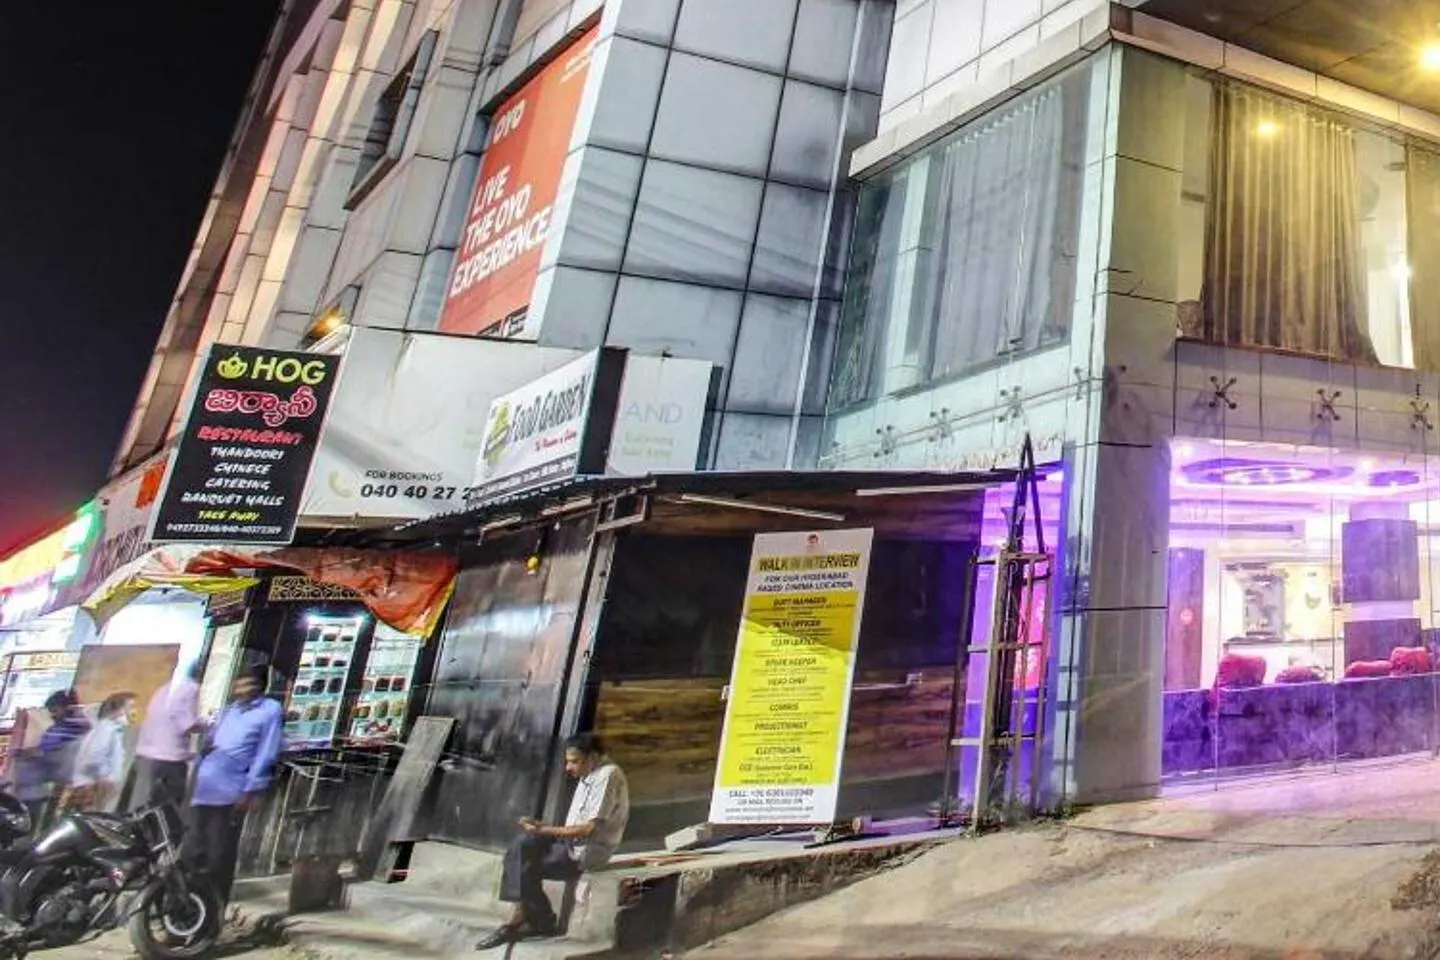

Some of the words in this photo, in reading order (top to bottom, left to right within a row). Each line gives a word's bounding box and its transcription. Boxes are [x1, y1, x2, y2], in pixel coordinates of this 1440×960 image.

[471, 164, 511, 218] LIVE
[463, 206, 497, 256] THE
[494, 183, 532, 233] OYO
[449, 205, 553, 298] EXPERIENCE
[252, 355, 326, 385] HOG
[204, 477, 271, 490] CATERING
[365, 469, 387, 479] FOR
[389, 470, 443, 481] BOOKINGS
[244, 495, 285, 507] HALLS
[360, 483, 398, 498] 040
[403, 485, 428, 498] 40
[431, 486, 456, 499] 27
